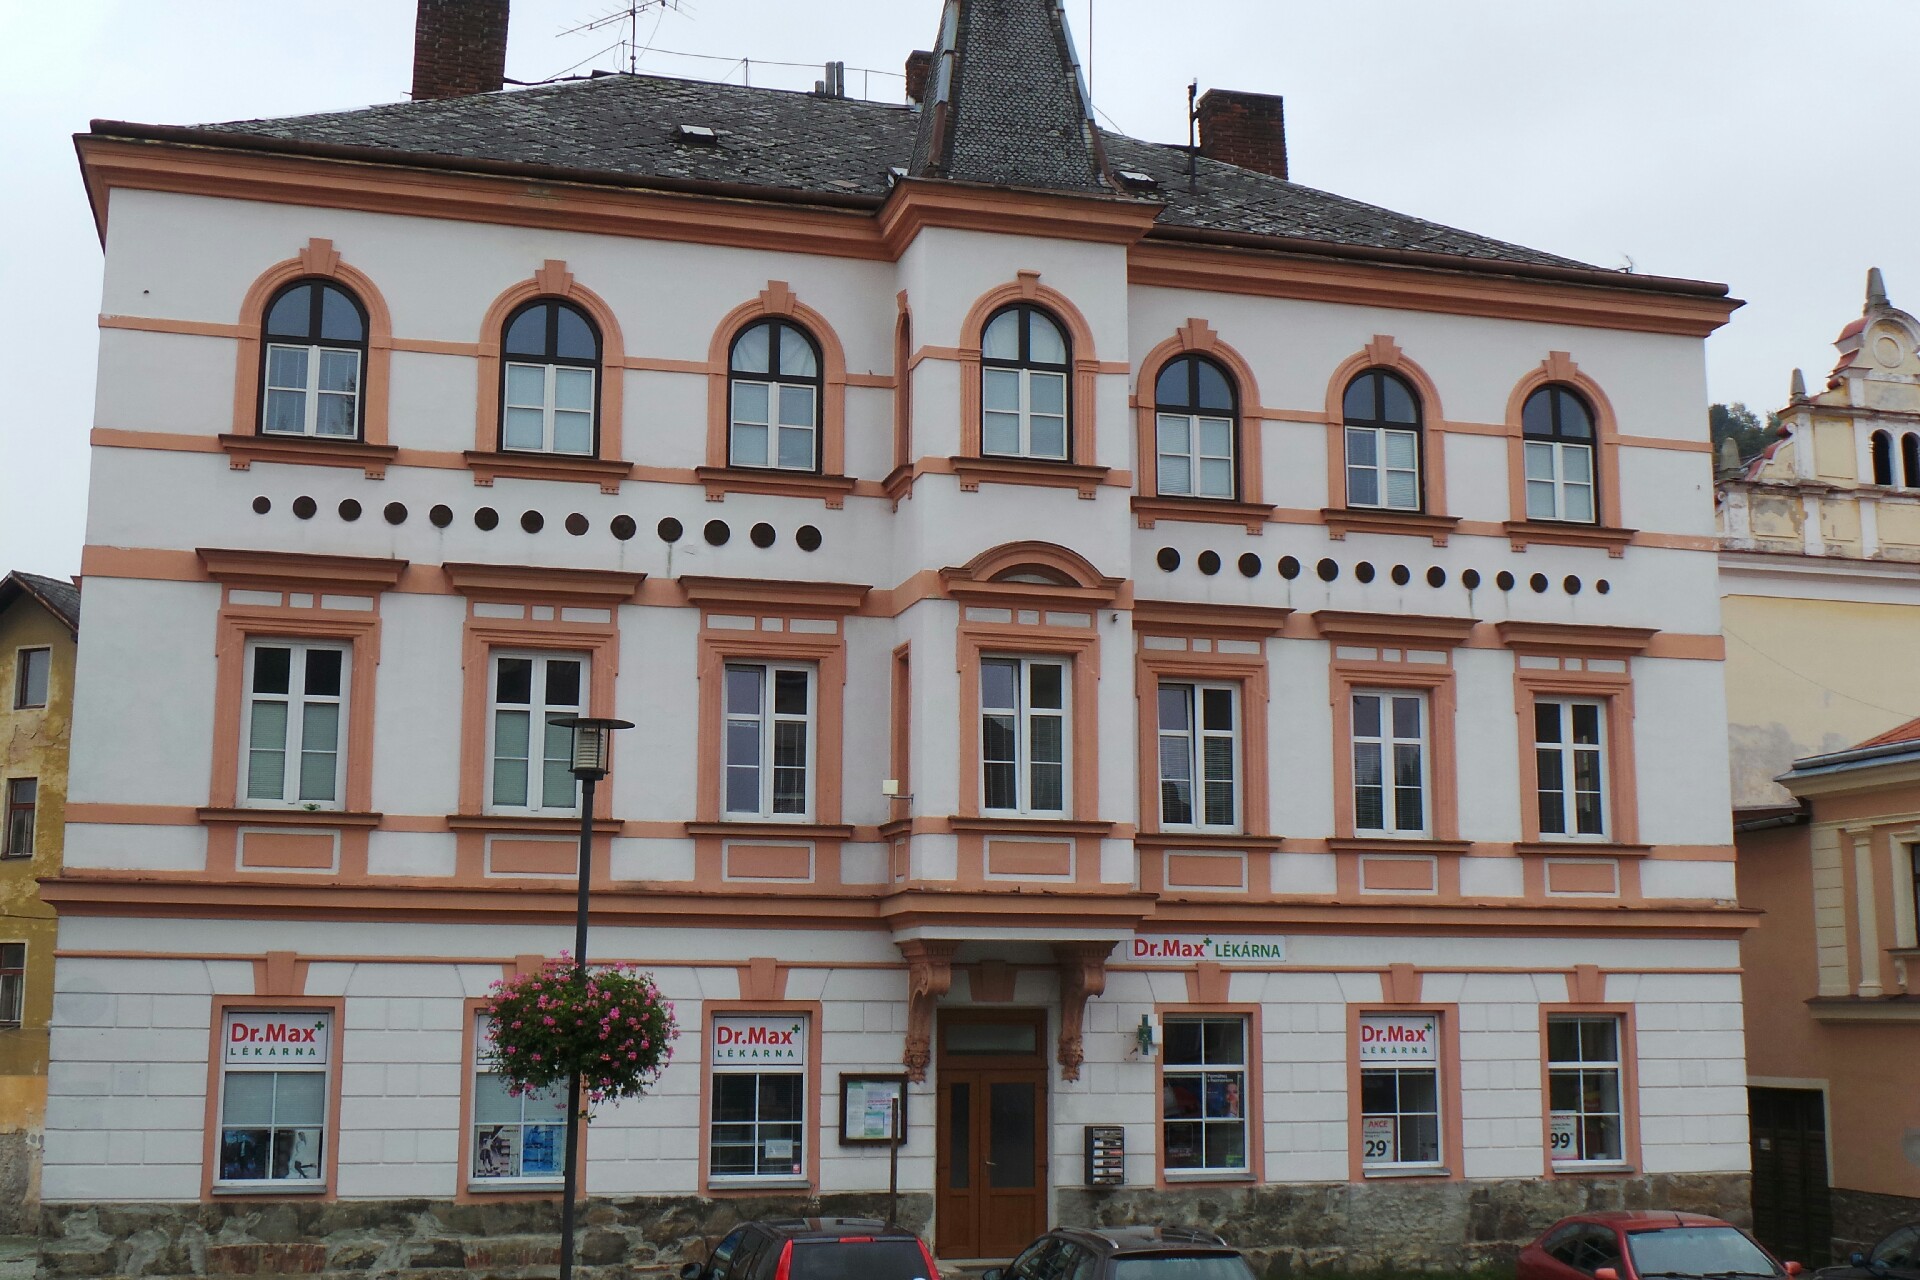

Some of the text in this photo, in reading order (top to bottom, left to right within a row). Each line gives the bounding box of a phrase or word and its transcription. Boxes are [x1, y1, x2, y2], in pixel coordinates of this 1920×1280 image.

[1134, 939, 1281, 957] Dr.Max LÉKÁRNA
[231, 1023, 315, 1042] Dr.Max
[717, 1026, 793, 1045] Dr.Max
[1362, 1025, 1426, 1042] Dr.Max
[230, 1046, 316, 1055] LÉKÁRNA
[717, 1048, 794, 1057] LÉKÁRNA
[1369, 1120, 1388, 1128] AKCE
[1365, 1140, 1387, 1157] 29
